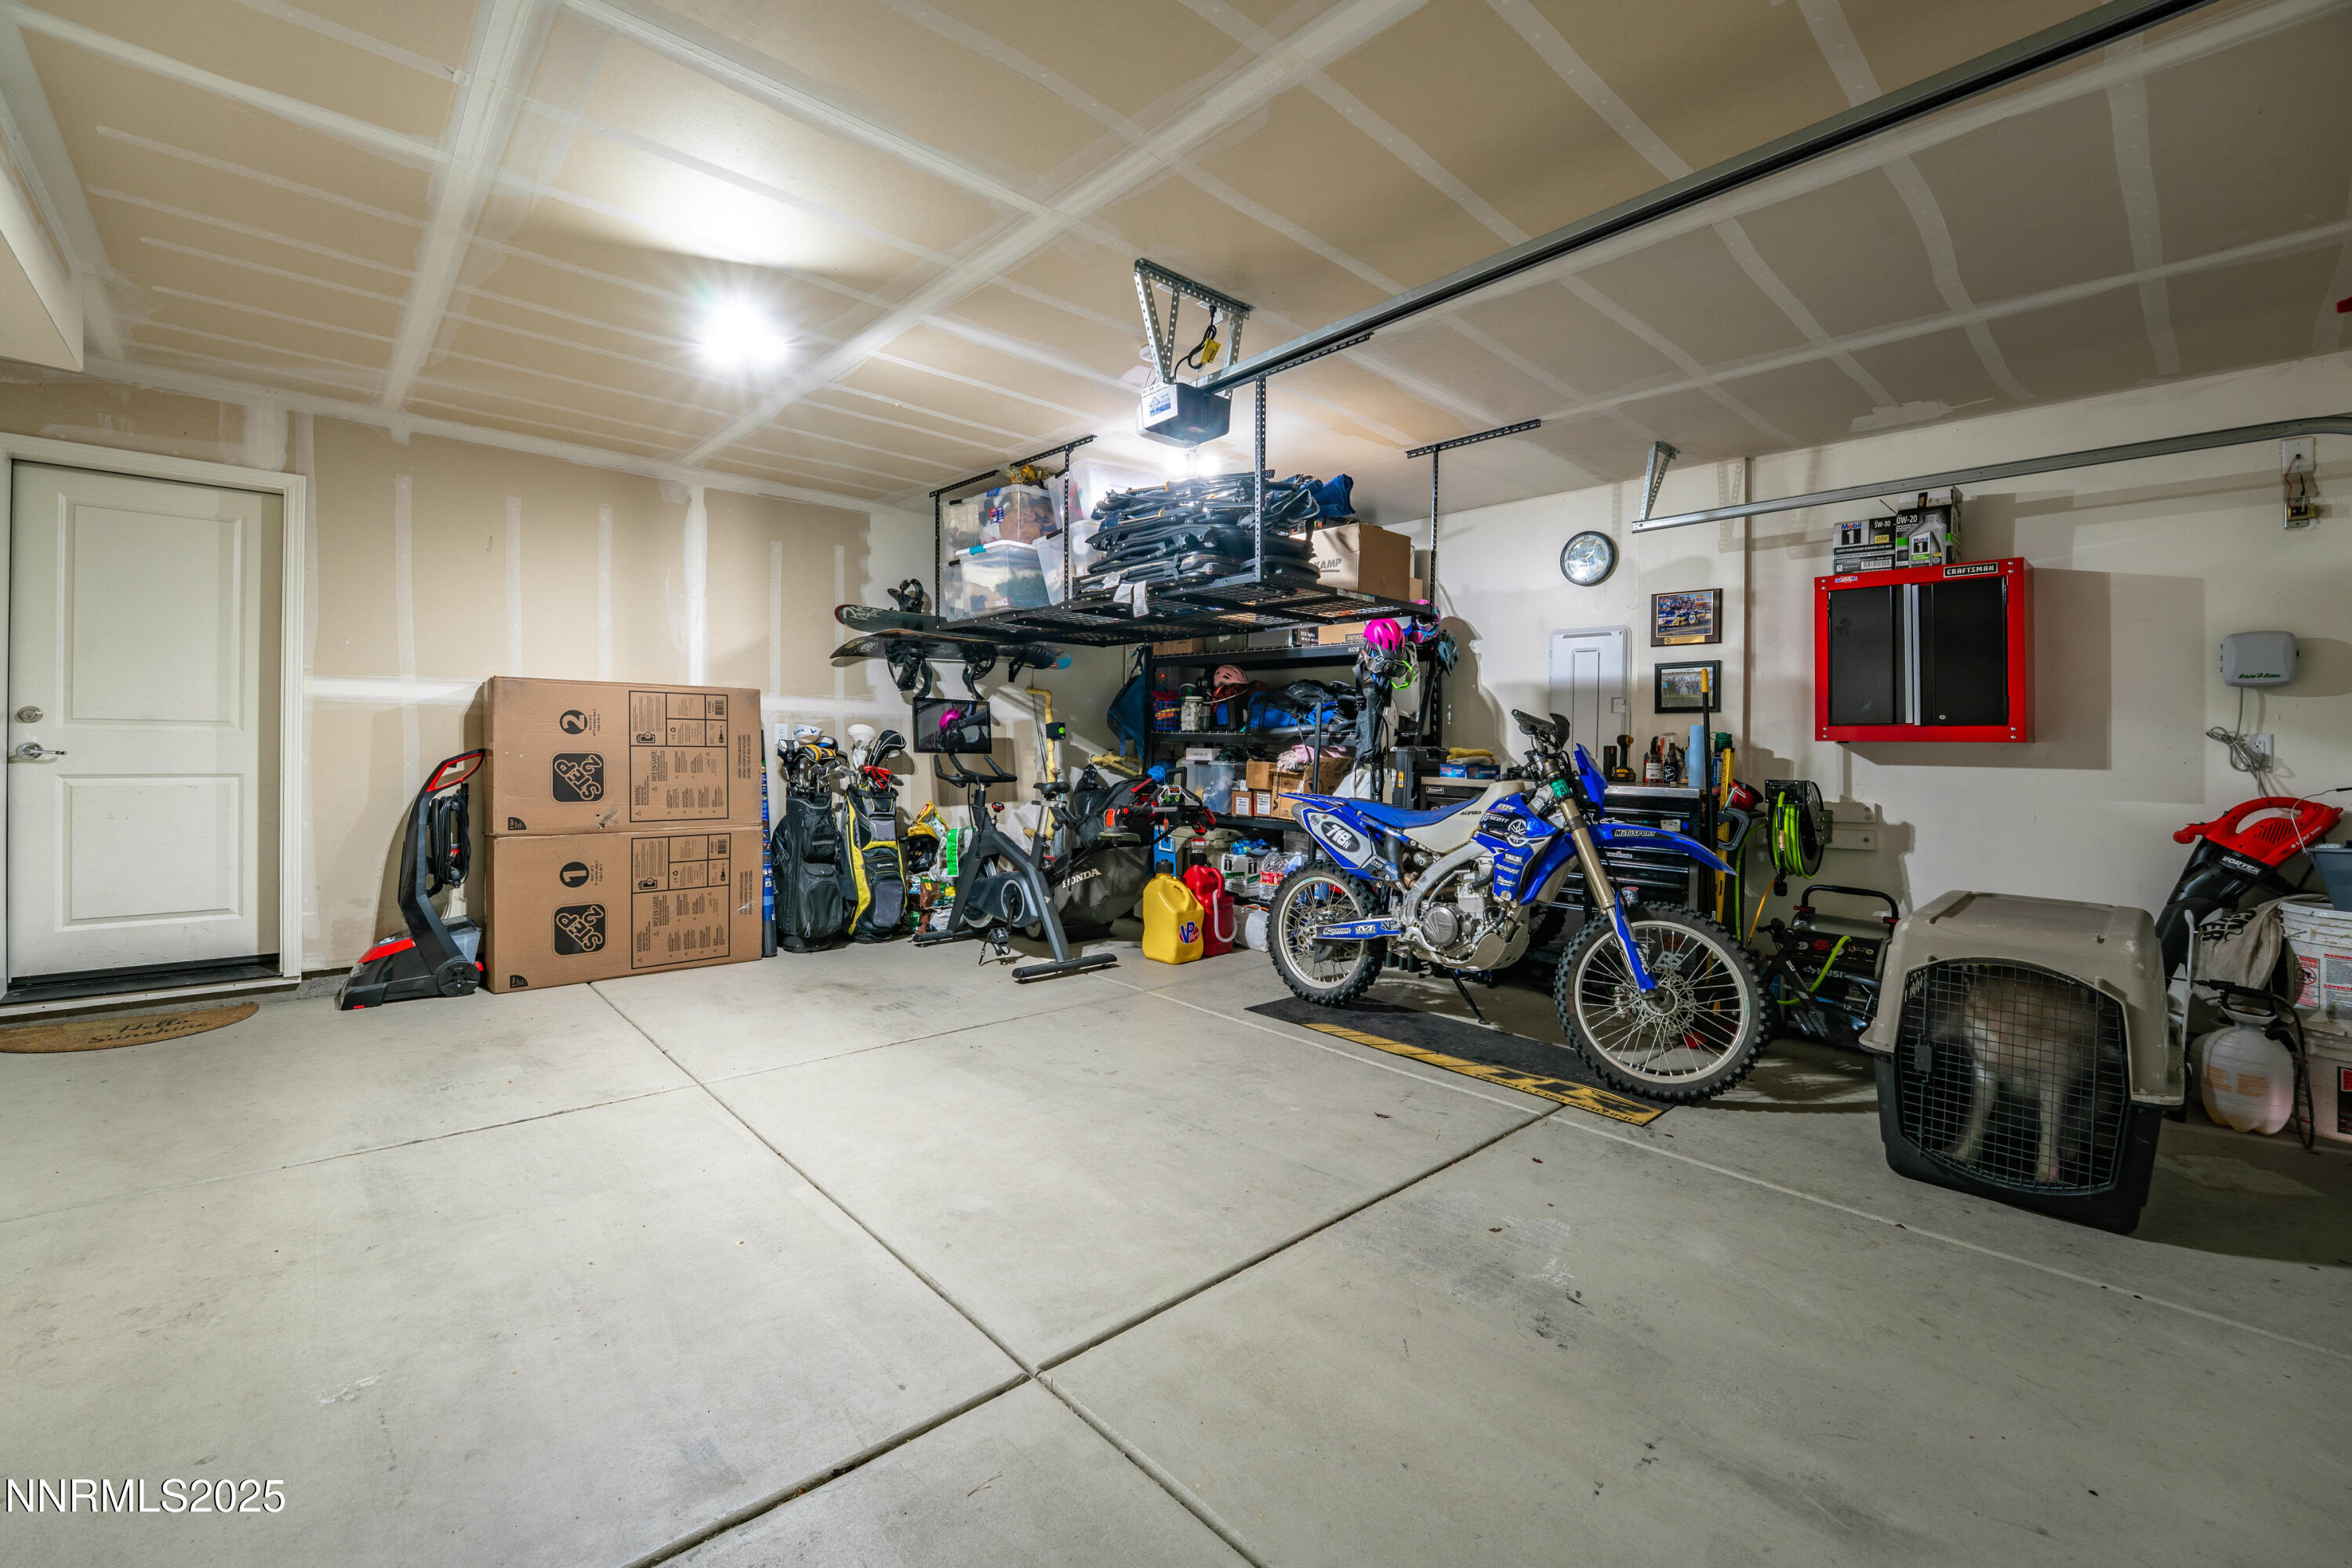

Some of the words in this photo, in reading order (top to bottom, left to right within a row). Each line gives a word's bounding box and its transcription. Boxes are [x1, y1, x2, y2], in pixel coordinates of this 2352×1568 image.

[1875, 520, 1890, 528] 5W-30
[1896, 515, 1918, 524] 0W-20
[1947, 565, 1994, 575] CRAFTSMAN
[562, 714, 585, 729] 2
[554, 759, 601, 800] STEP
[581, 754, 602, 774] 2
[1326, 824, 1352, 846] 718
[2222, 856, 2261, 873] VORTEX
[563, 870, 586, 882] 1
[1062, 868, 1102, 889] HONDA
[556, 913, 603, 951] STEP
[583, 906, 604, 925] 2
[1180, 922, 1196, 943] VP
[1817, 967, 1846, 978] HUSK
[88, 1022, 211, 1044] Sunshine
[117, 1018, 191, 1033] Hello
[1474, 1073, 1519, 1087] TEAM
